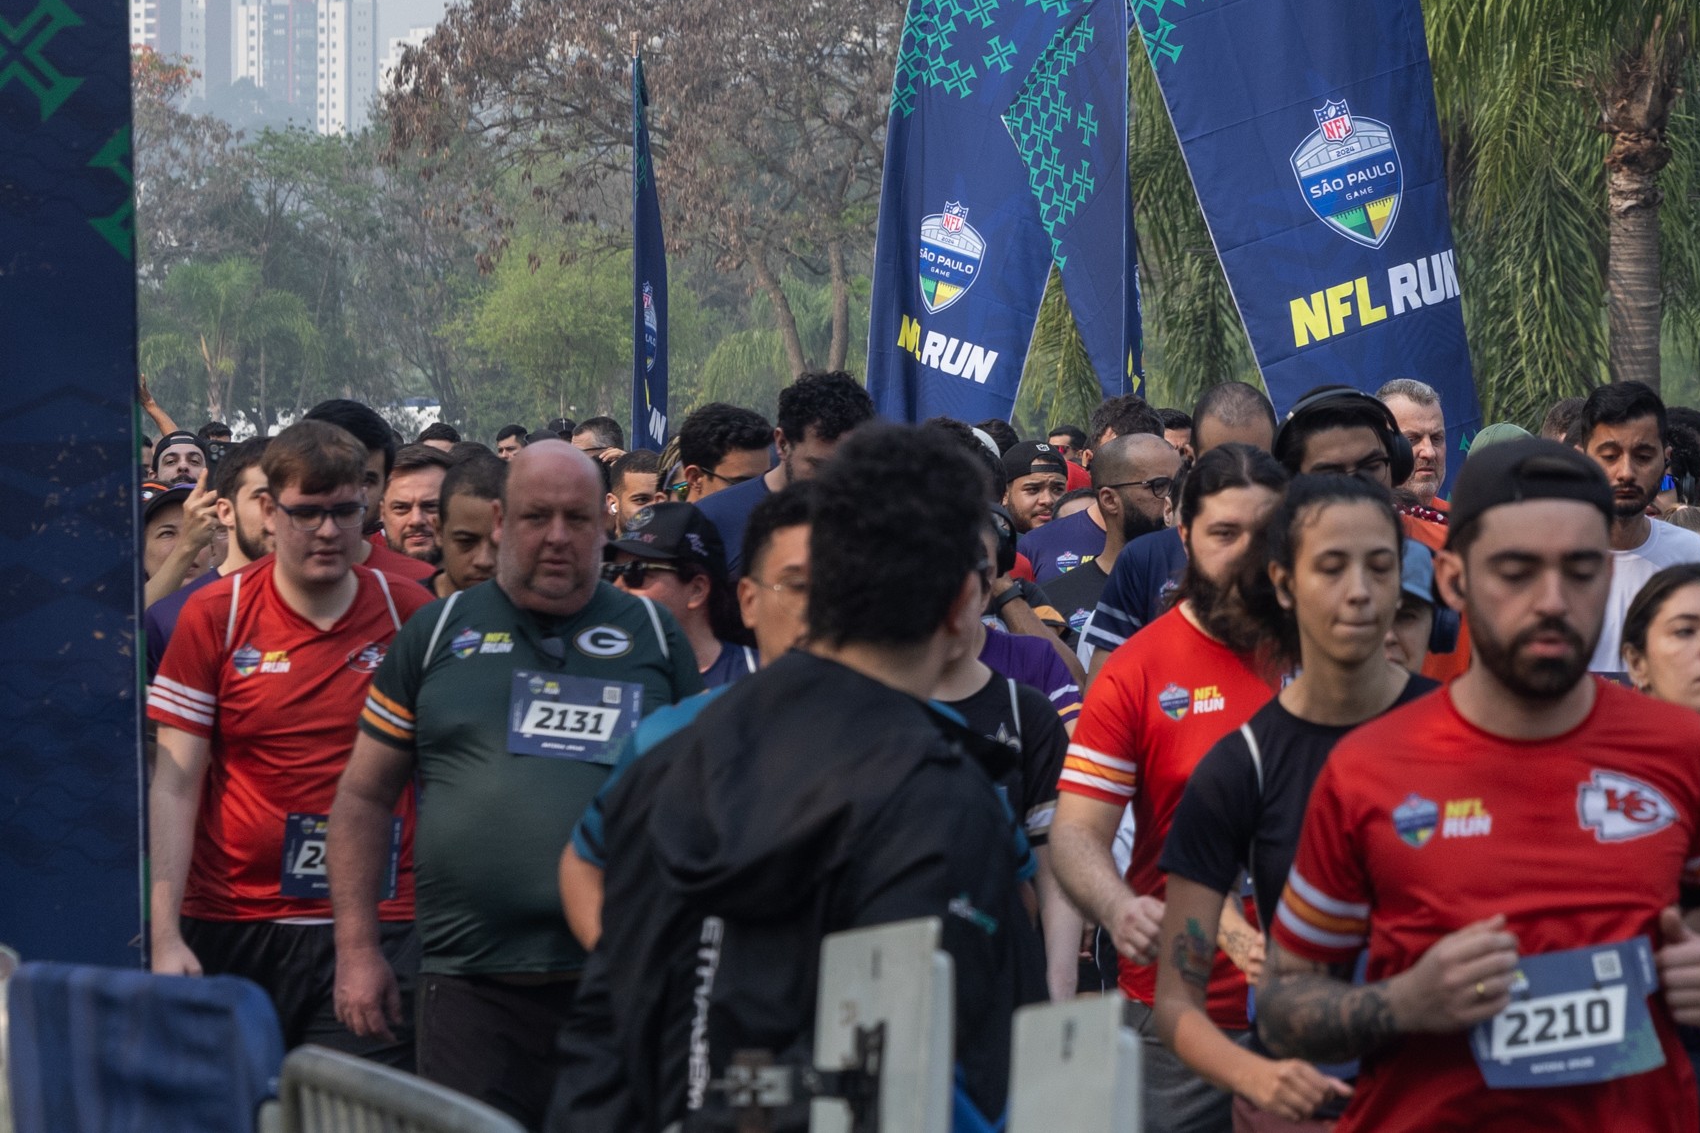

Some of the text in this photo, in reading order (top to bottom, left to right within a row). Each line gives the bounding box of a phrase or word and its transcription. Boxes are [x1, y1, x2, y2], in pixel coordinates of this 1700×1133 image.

[1323, 116, 1351, 140] NFL
[1335, 145, 1355, 158] 2024
[1310, 161, 1396, 199] SÃO PAULO
[1345, 186, 1374, 201] GAME
[943, 214, 961, 231] NFL
[930, 266, 951, 278] GAME
[937, 254, 974, 275] PAULO
[1289, 276, 1387, 348] NFL
[921, 330, 999, 384] RUN
[577, 626, 631, 656] G
[1194, 685, 1221, 701] NFL
[1193, 697, 1225, 715] RUN
[534, 707, 604, 735] 2131
[1505, 997, 1612, 1049] 2210
